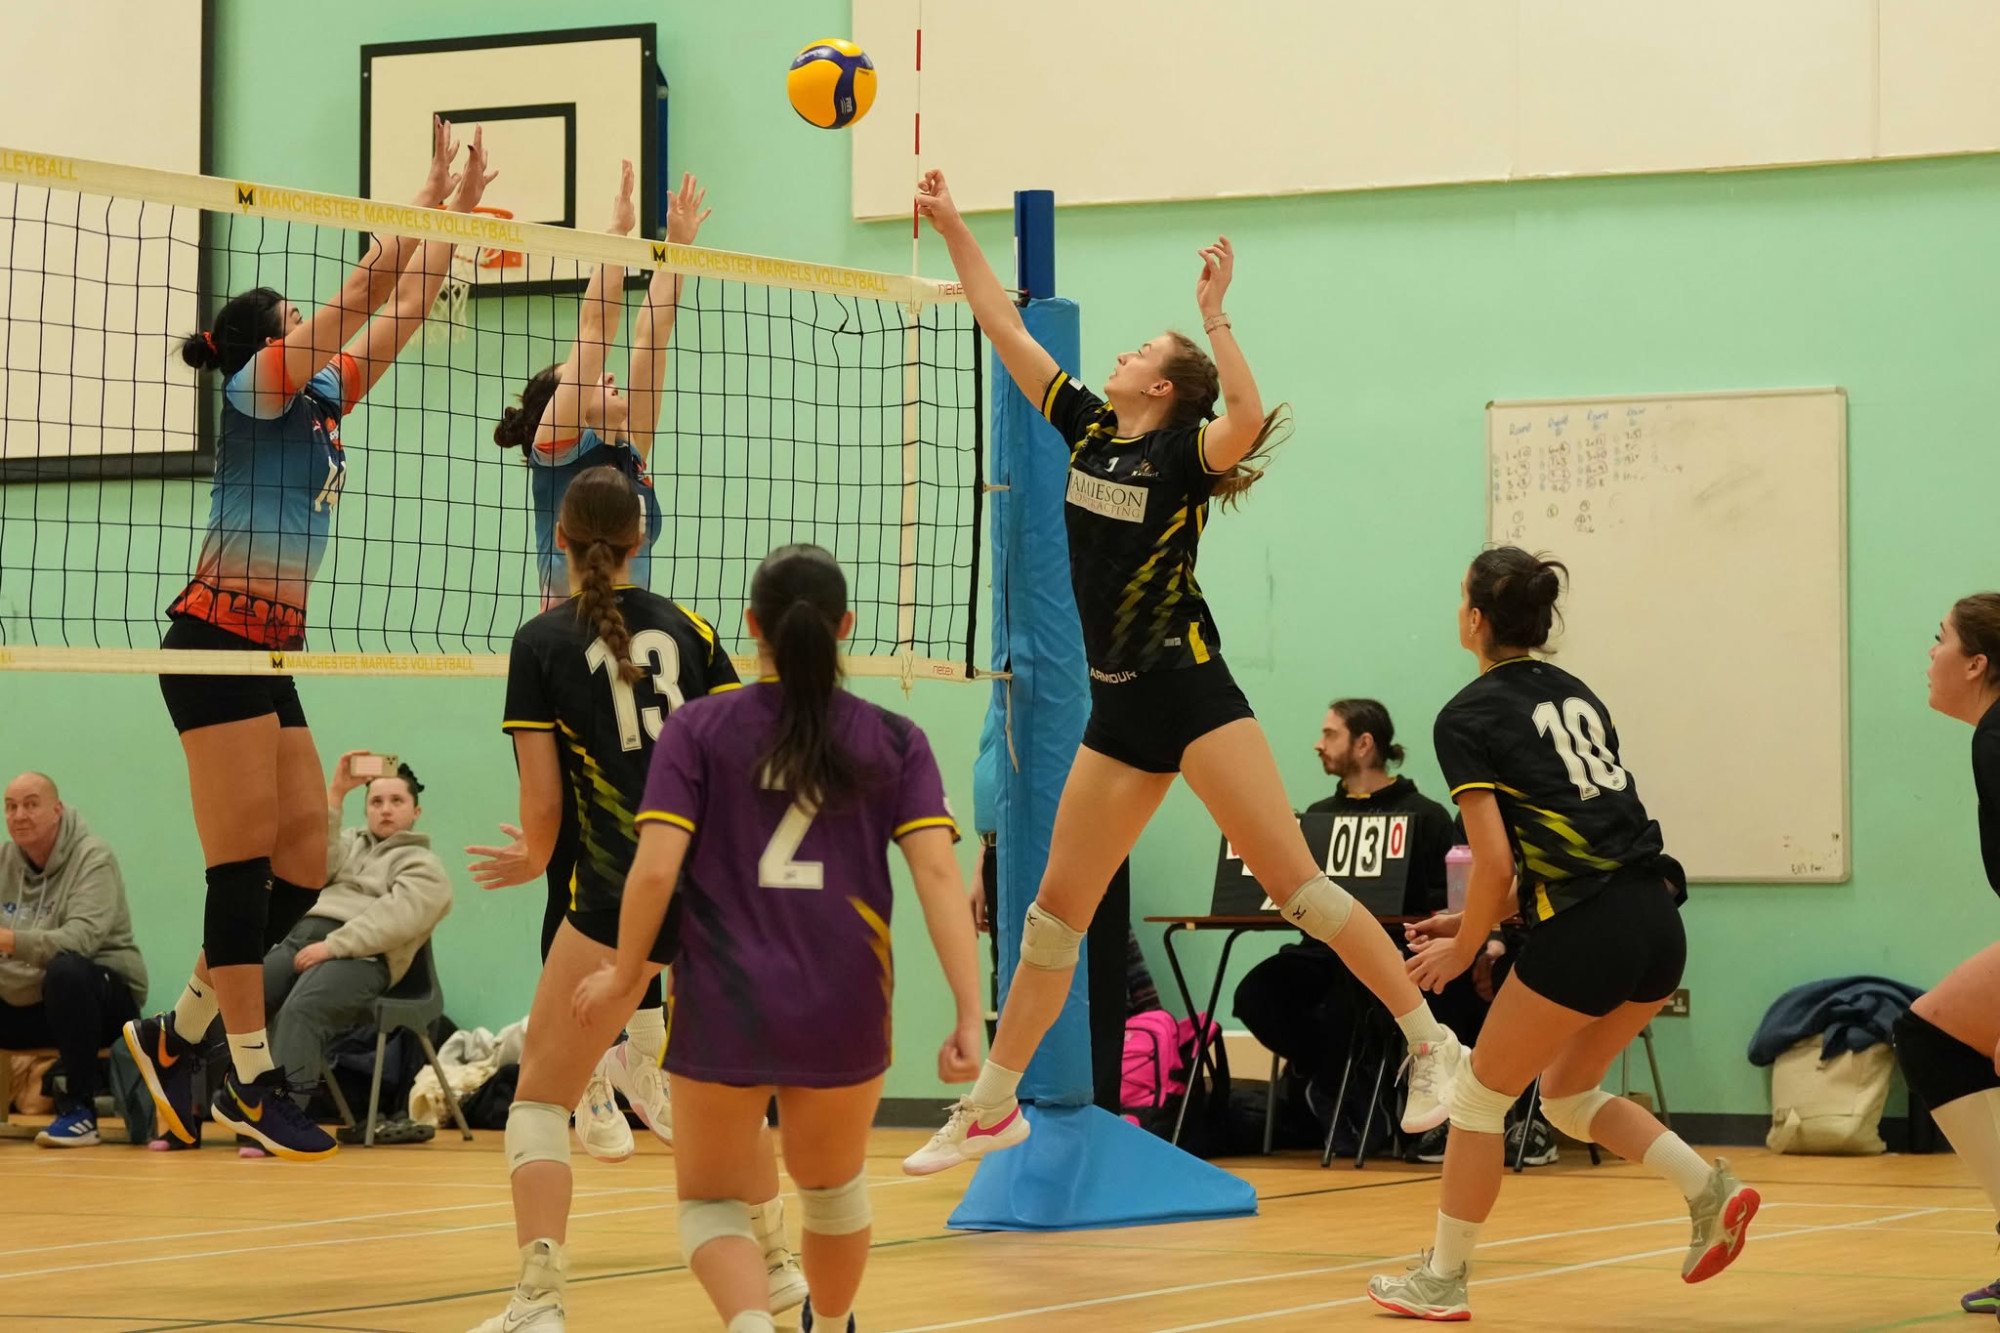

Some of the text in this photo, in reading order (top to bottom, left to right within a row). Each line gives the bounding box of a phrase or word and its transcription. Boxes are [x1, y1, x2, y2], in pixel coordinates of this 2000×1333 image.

[0, 152, 78, 181] LEYBALL
[259, 190, 359, 219] MANCHESTER
[364, 205, 431, 231] MARVELS
[435, 215, 524, 243] VOLLEYBALL
[670, 250, 752, 274] MANCHESTER
[756, 260, 812, 282] MARVELS
[815, 266, 888, 292] VOLLEYBALL
[938, 283, 964, 295] nete
[286, 655, 357, 670] MANCHESTER
[360, 656, 409, 670] MARVELS
[410, 656, 475, 671] VOLLEYBALL
[932, 664, 955, 677] netex
[585, 629, 686, 752] 13
[1531, 696, 1628, 802] 10
